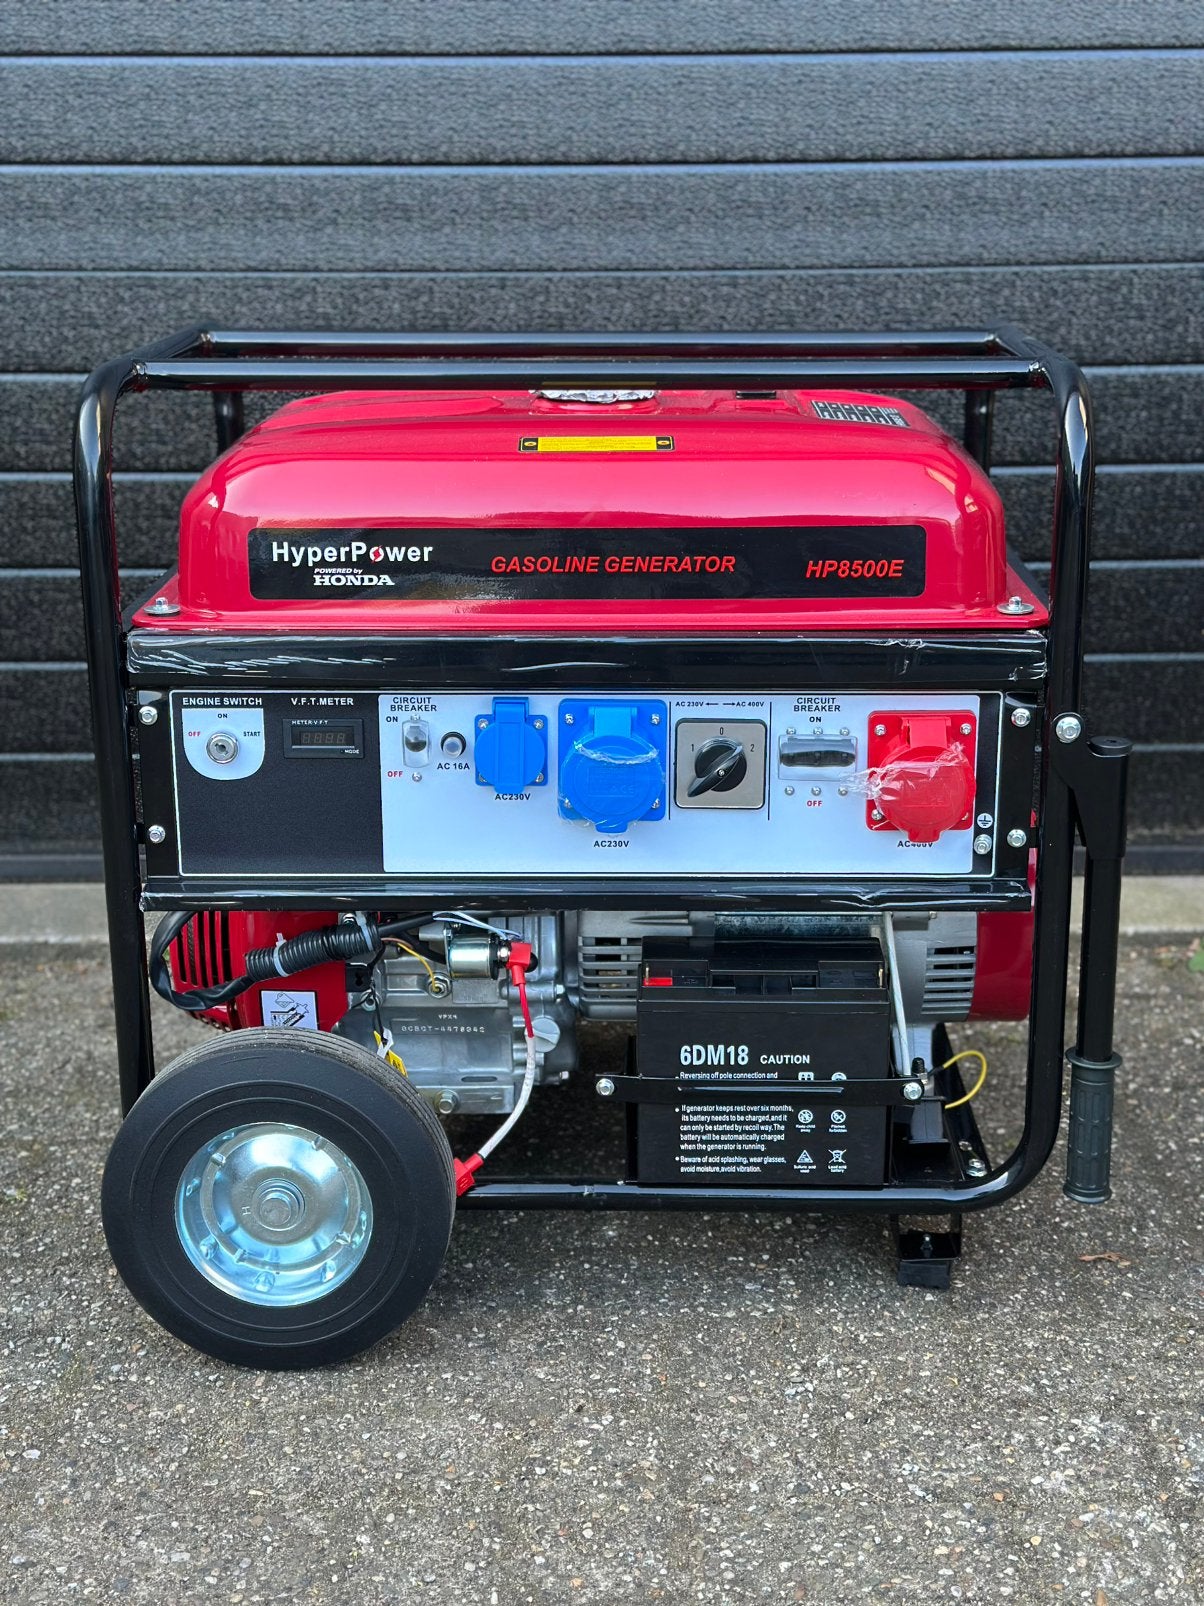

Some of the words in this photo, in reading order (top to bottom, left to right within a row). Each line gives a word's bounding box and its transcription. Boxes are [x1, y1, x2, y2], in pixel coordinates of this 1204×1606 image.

[271, 541, 433, 567] HyperPower
[491, 556, 600, 574] GASOLINE
[604, 556, 736, 573] GENERATOR
[805, 559, 905, 578] HP8500E
[313, 574, 396, 586] HONDA
[182, 697, 221, 706] ENGINE
[223, 697, 263, 706] SWITCH
[291, 698, 354, 706] V.F.T.METER
[392, 696, 432, 704] CIRCUIT
[390, 704, 438, 712] BREAKER
[793, 704, 841, 712] BREAKER
[719, 727, 724, 736] 0
[691, 744, 695, 752] 1
[750, 744, 755, 752] 2
[436, 762, 450, 770] AC
[453, 762, 470, 770] 16A
[494, 793, 531, 801] AC230V
[593, 840, 630, 848] AC230V
[680, 1044, 749, 1066] 6DM18
[760, 1054, 811, 1064] CAUTION
[686, 1105, 715, 1113] generator
[716, 1105, 734, 1113] keeps
[690, 1114, 710, 1122] battery
[692, 1124, 704, 1132] only
[734, 1124, 742, 1132] by
[680, 1134, 701, 1142] battery
[720, 1134, 760, 1142] automatically
[760, 1134, 785, 1142] charged
[706, 1144, 736, 1152] generator
[742, 1144, 766, 1152] running.
